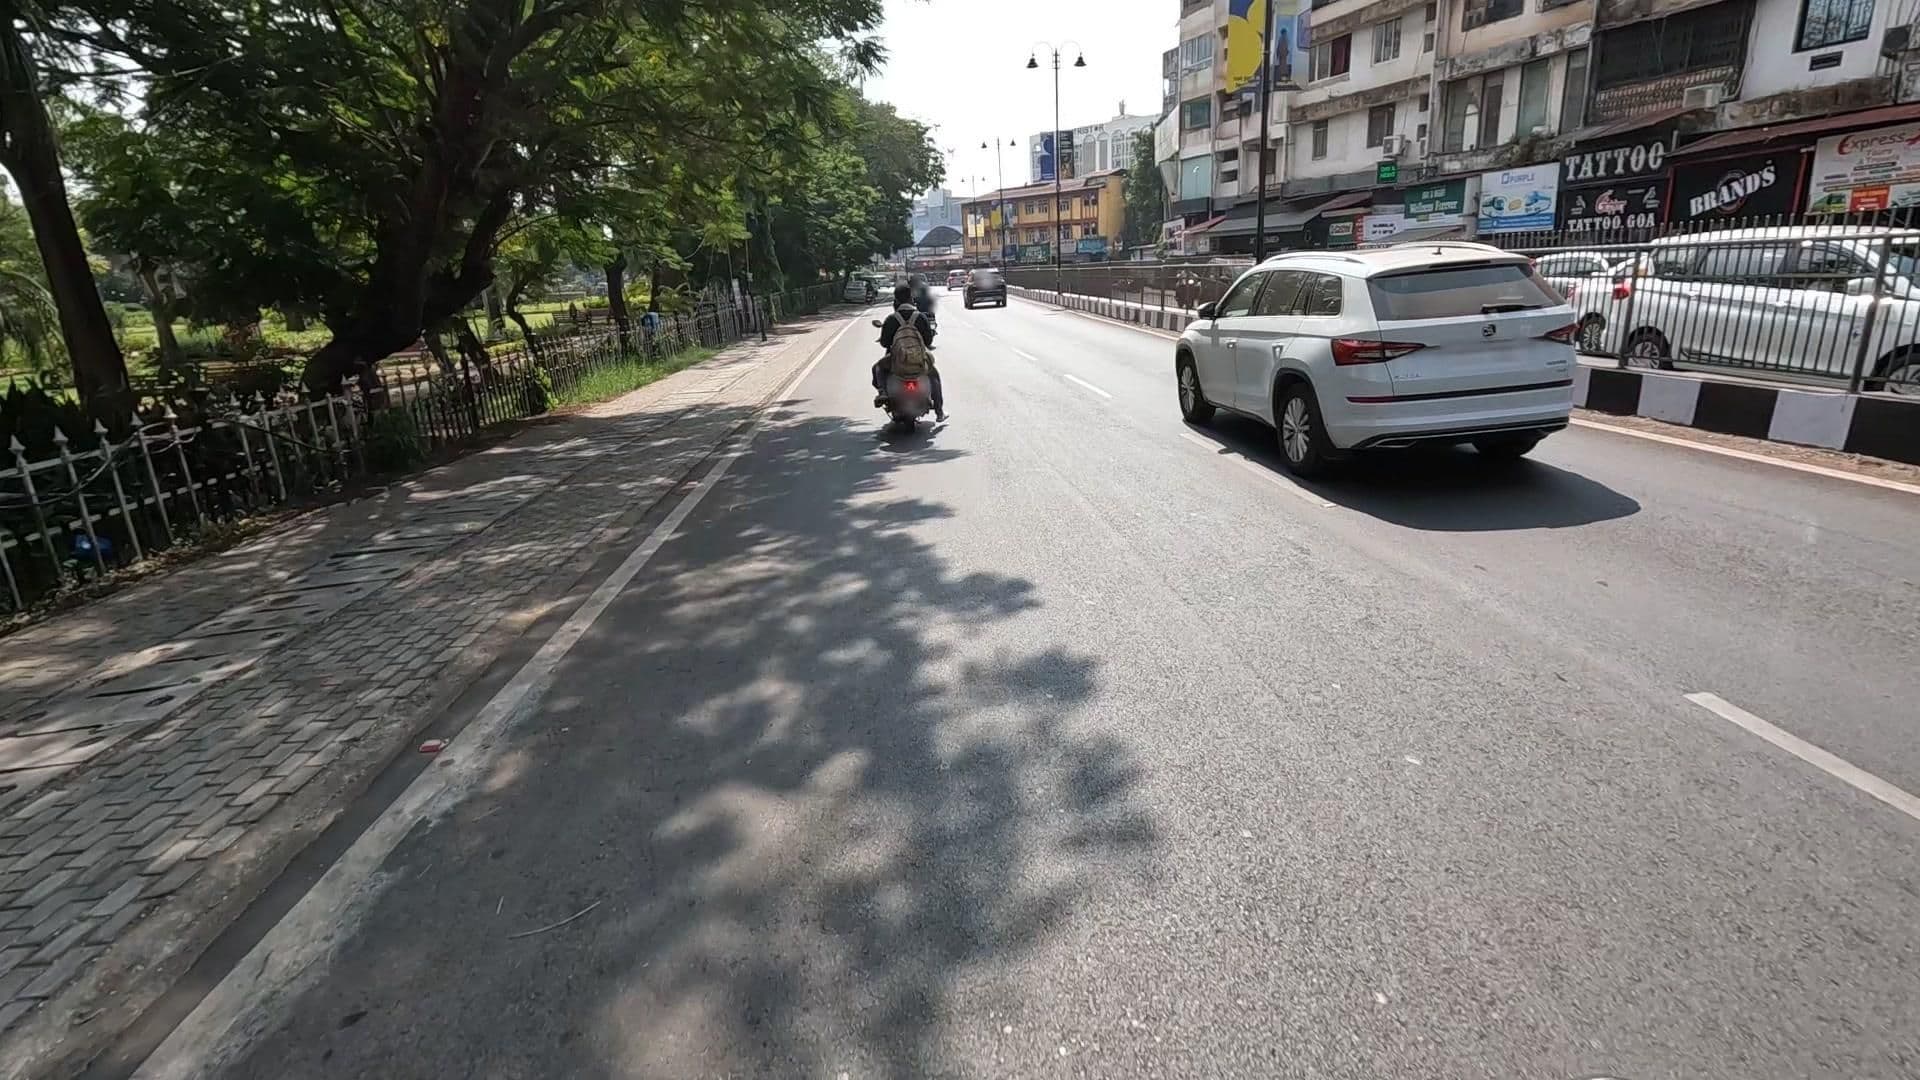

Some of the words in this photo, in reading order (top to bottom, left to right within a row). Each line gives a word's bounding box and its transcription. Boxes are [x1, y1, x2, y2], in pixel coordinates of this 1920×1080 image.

[1838, 132, 1906, 155] Express
[1565, 142, 1665, 181] TATTOO
[1626, 212, 1655, 228] GOA
